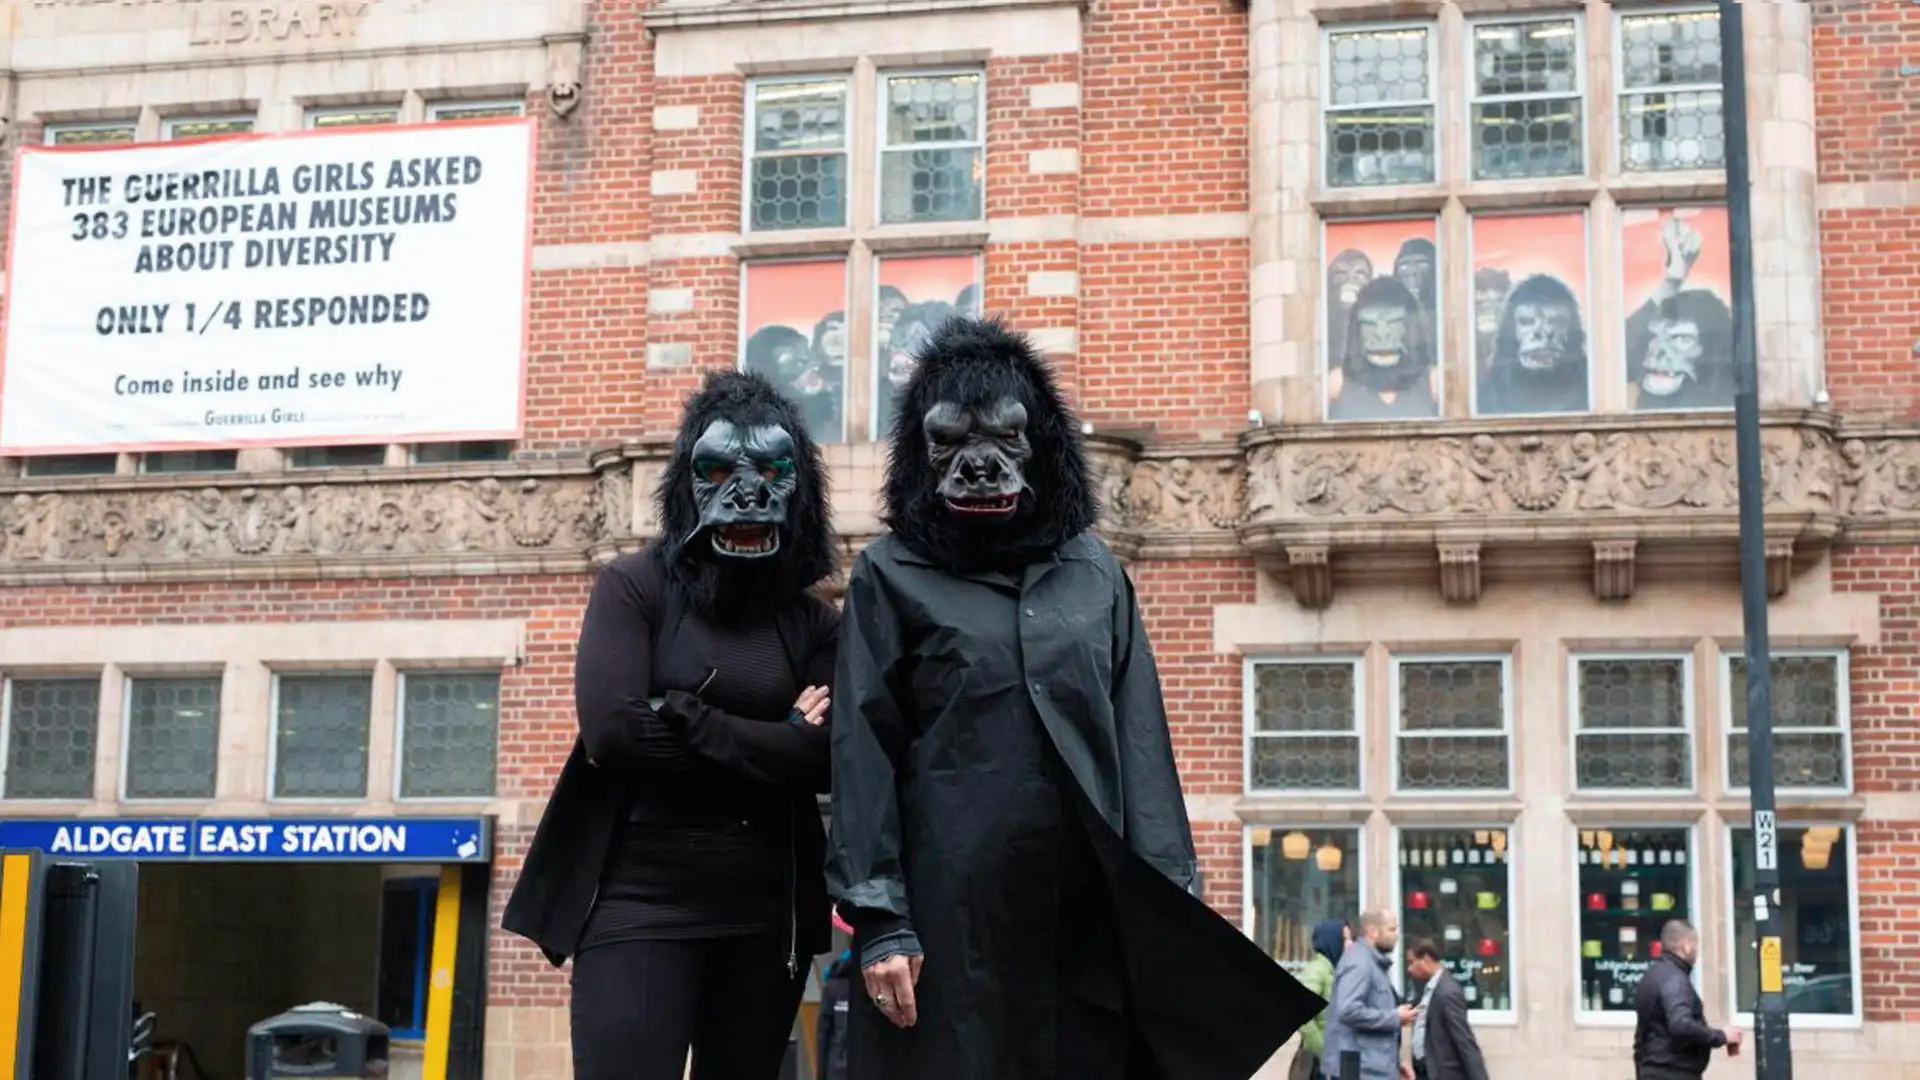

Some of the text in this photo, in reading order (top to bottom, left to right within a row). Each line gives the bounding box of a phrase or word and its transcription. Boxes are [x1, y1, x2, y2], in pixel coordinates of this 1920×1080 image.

[189, 2, 369, 46] LIBRARY
[63, 155, 482, 206] THE GUERRILLA GIRLS ASKED
[71, 193, 457, 242] 383 EUROPEAN MUSEUMS
[134, 232, 396, 274] ABOUT DIVERSITY
[95, 292, 430, 336] ONLY 1/4 RESPONDED
[114, 363, 403, 396] Come inside and see why
[51, 825, 406, 853] ALDGATE EAST STATION
